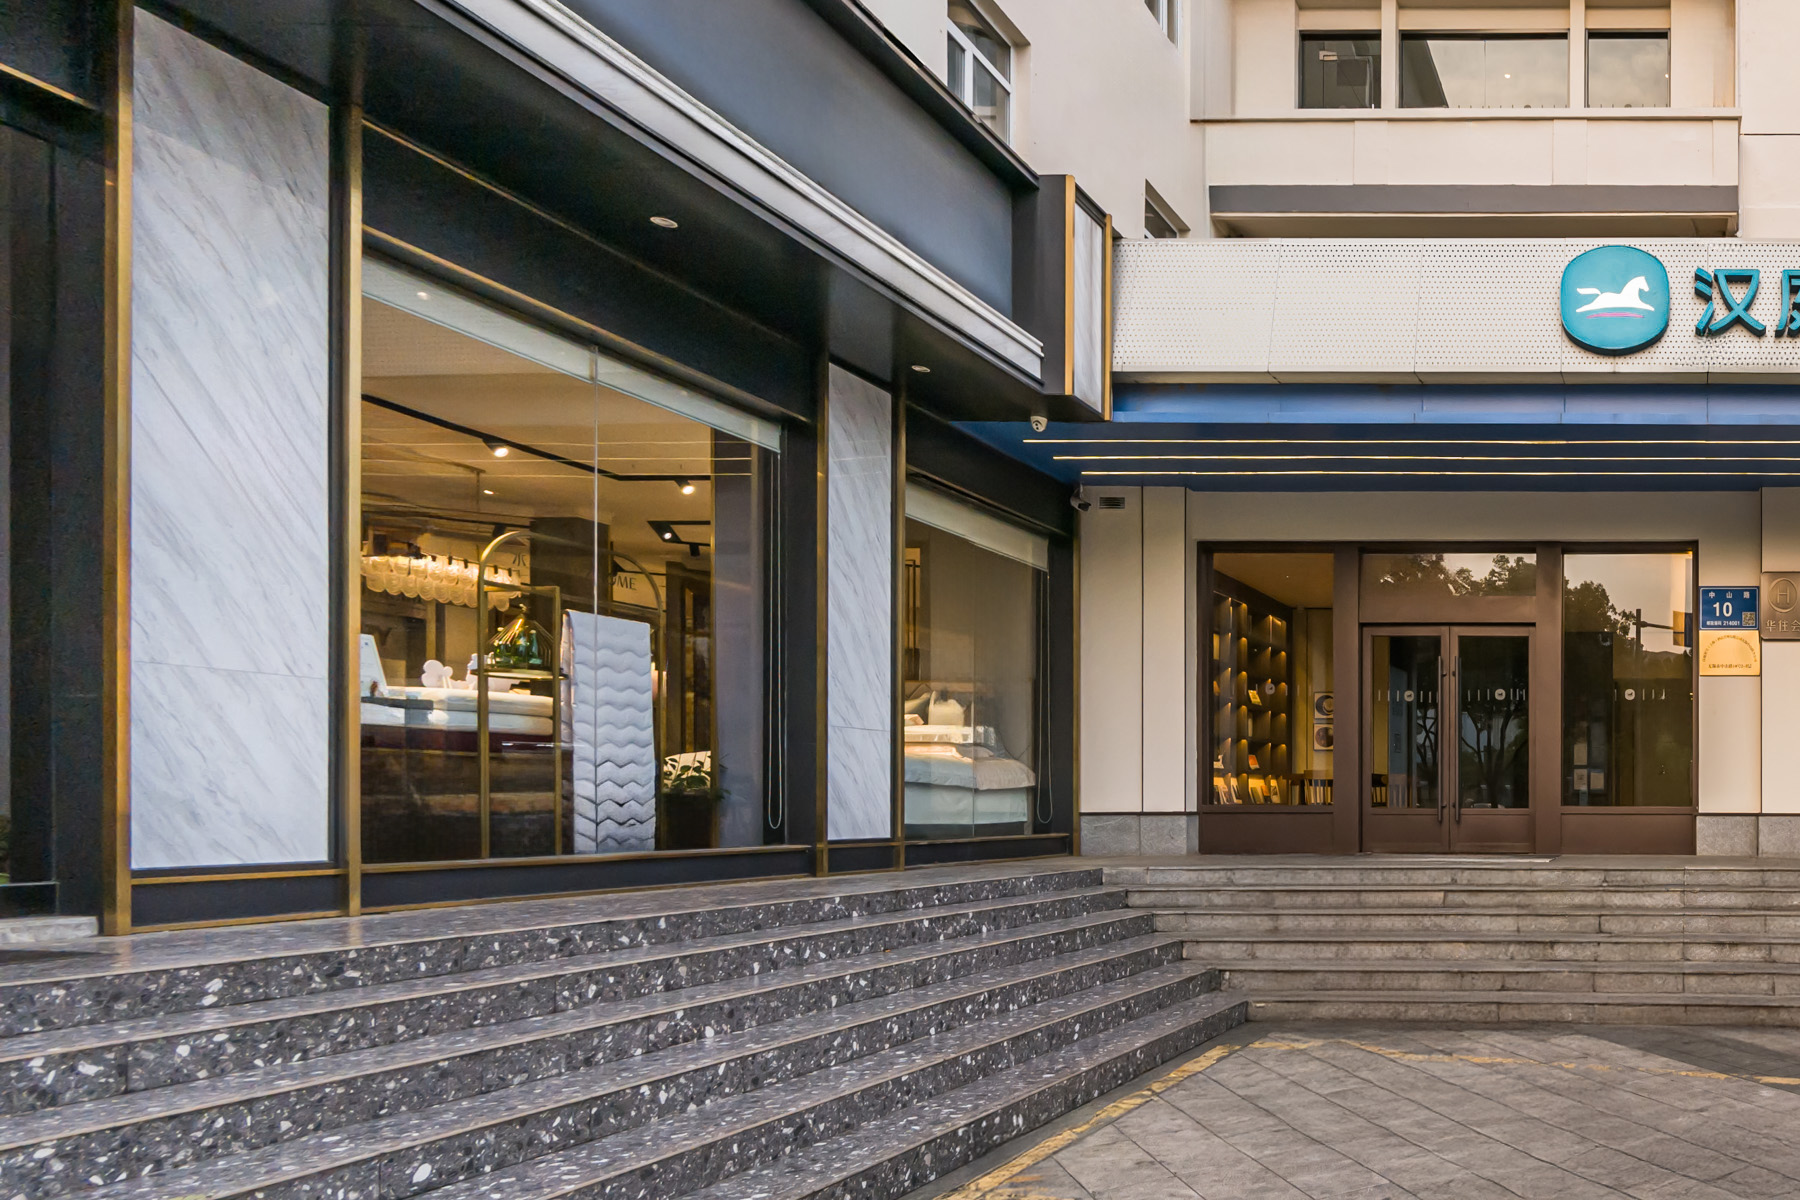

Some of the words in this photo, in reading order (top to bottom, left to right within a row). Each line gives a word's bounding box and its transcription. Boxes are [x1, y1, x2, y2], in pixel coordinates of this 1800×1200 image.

[1708, 591, 1750, 599] 中山路
[1712, 602, 1733, 617] 10
[1766, 619, 1800, 632] 华住会
